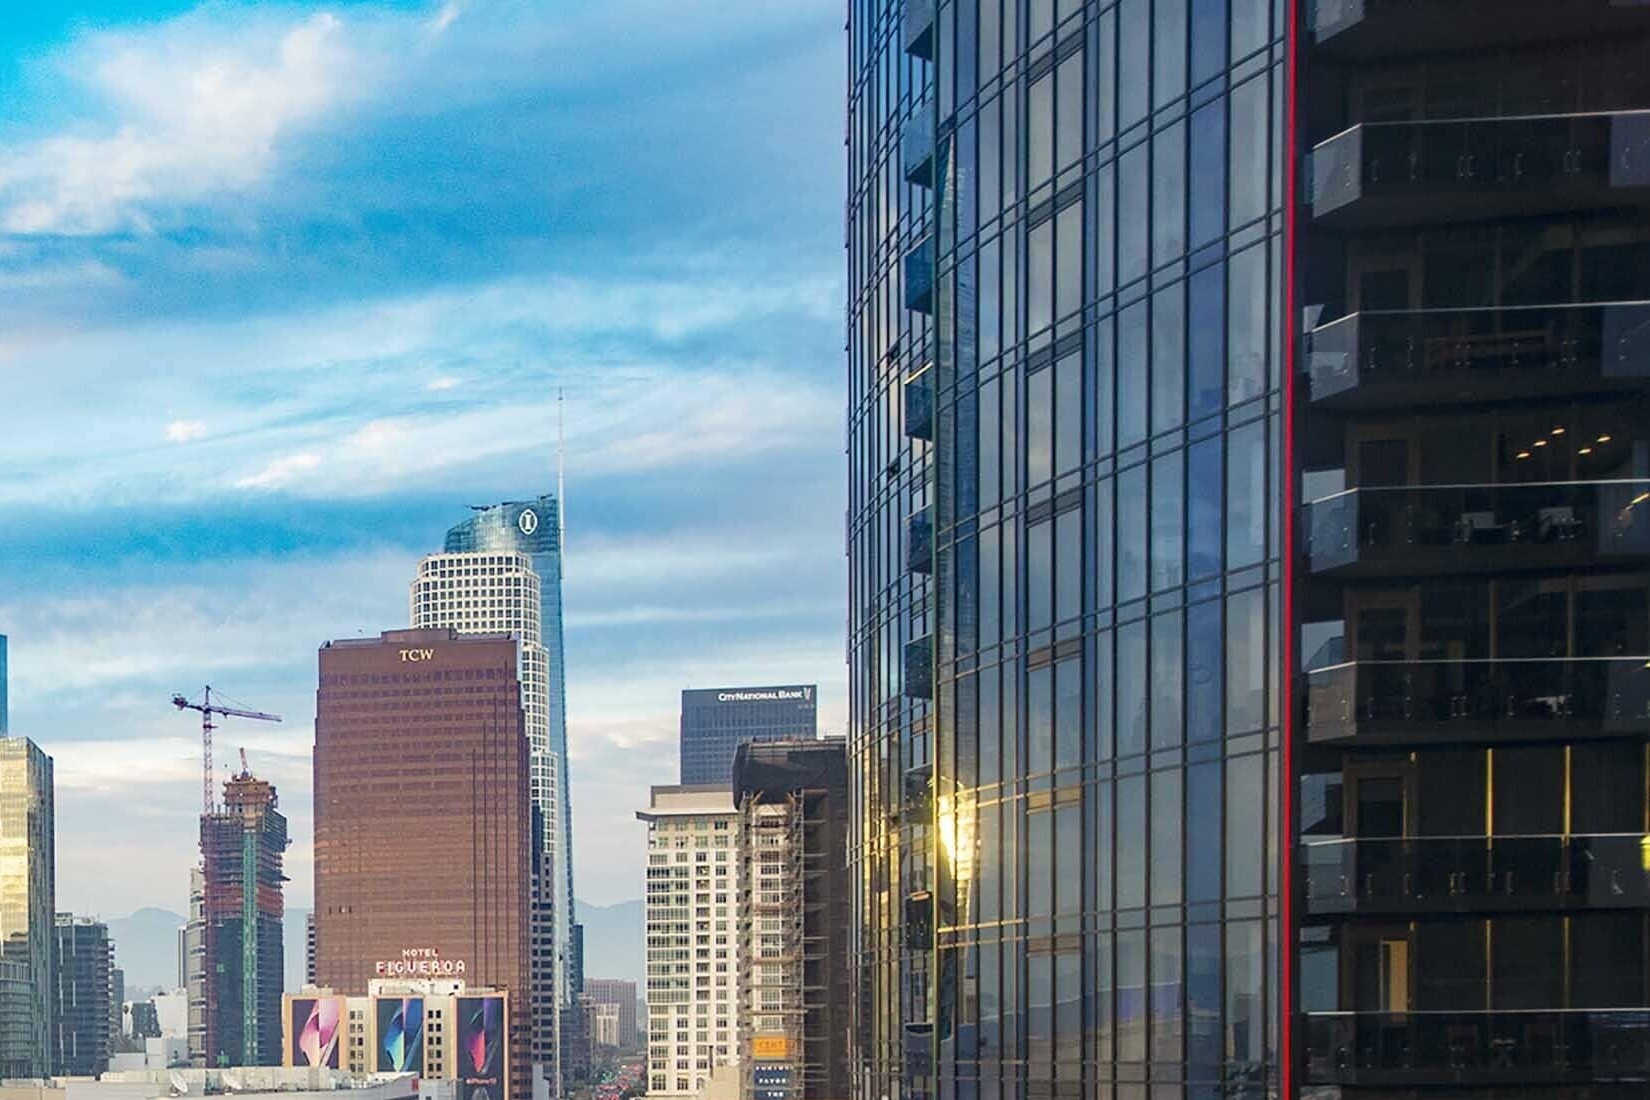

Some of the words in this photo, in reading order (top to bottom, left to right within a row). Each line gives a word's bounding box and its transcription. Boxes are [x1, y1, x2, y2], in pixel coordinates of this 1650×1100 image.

[399, 649, 434, 661] TCW
[402, 948, 439, 957] HOTEL
[376, 960, 466, 974] FIGUEROA
